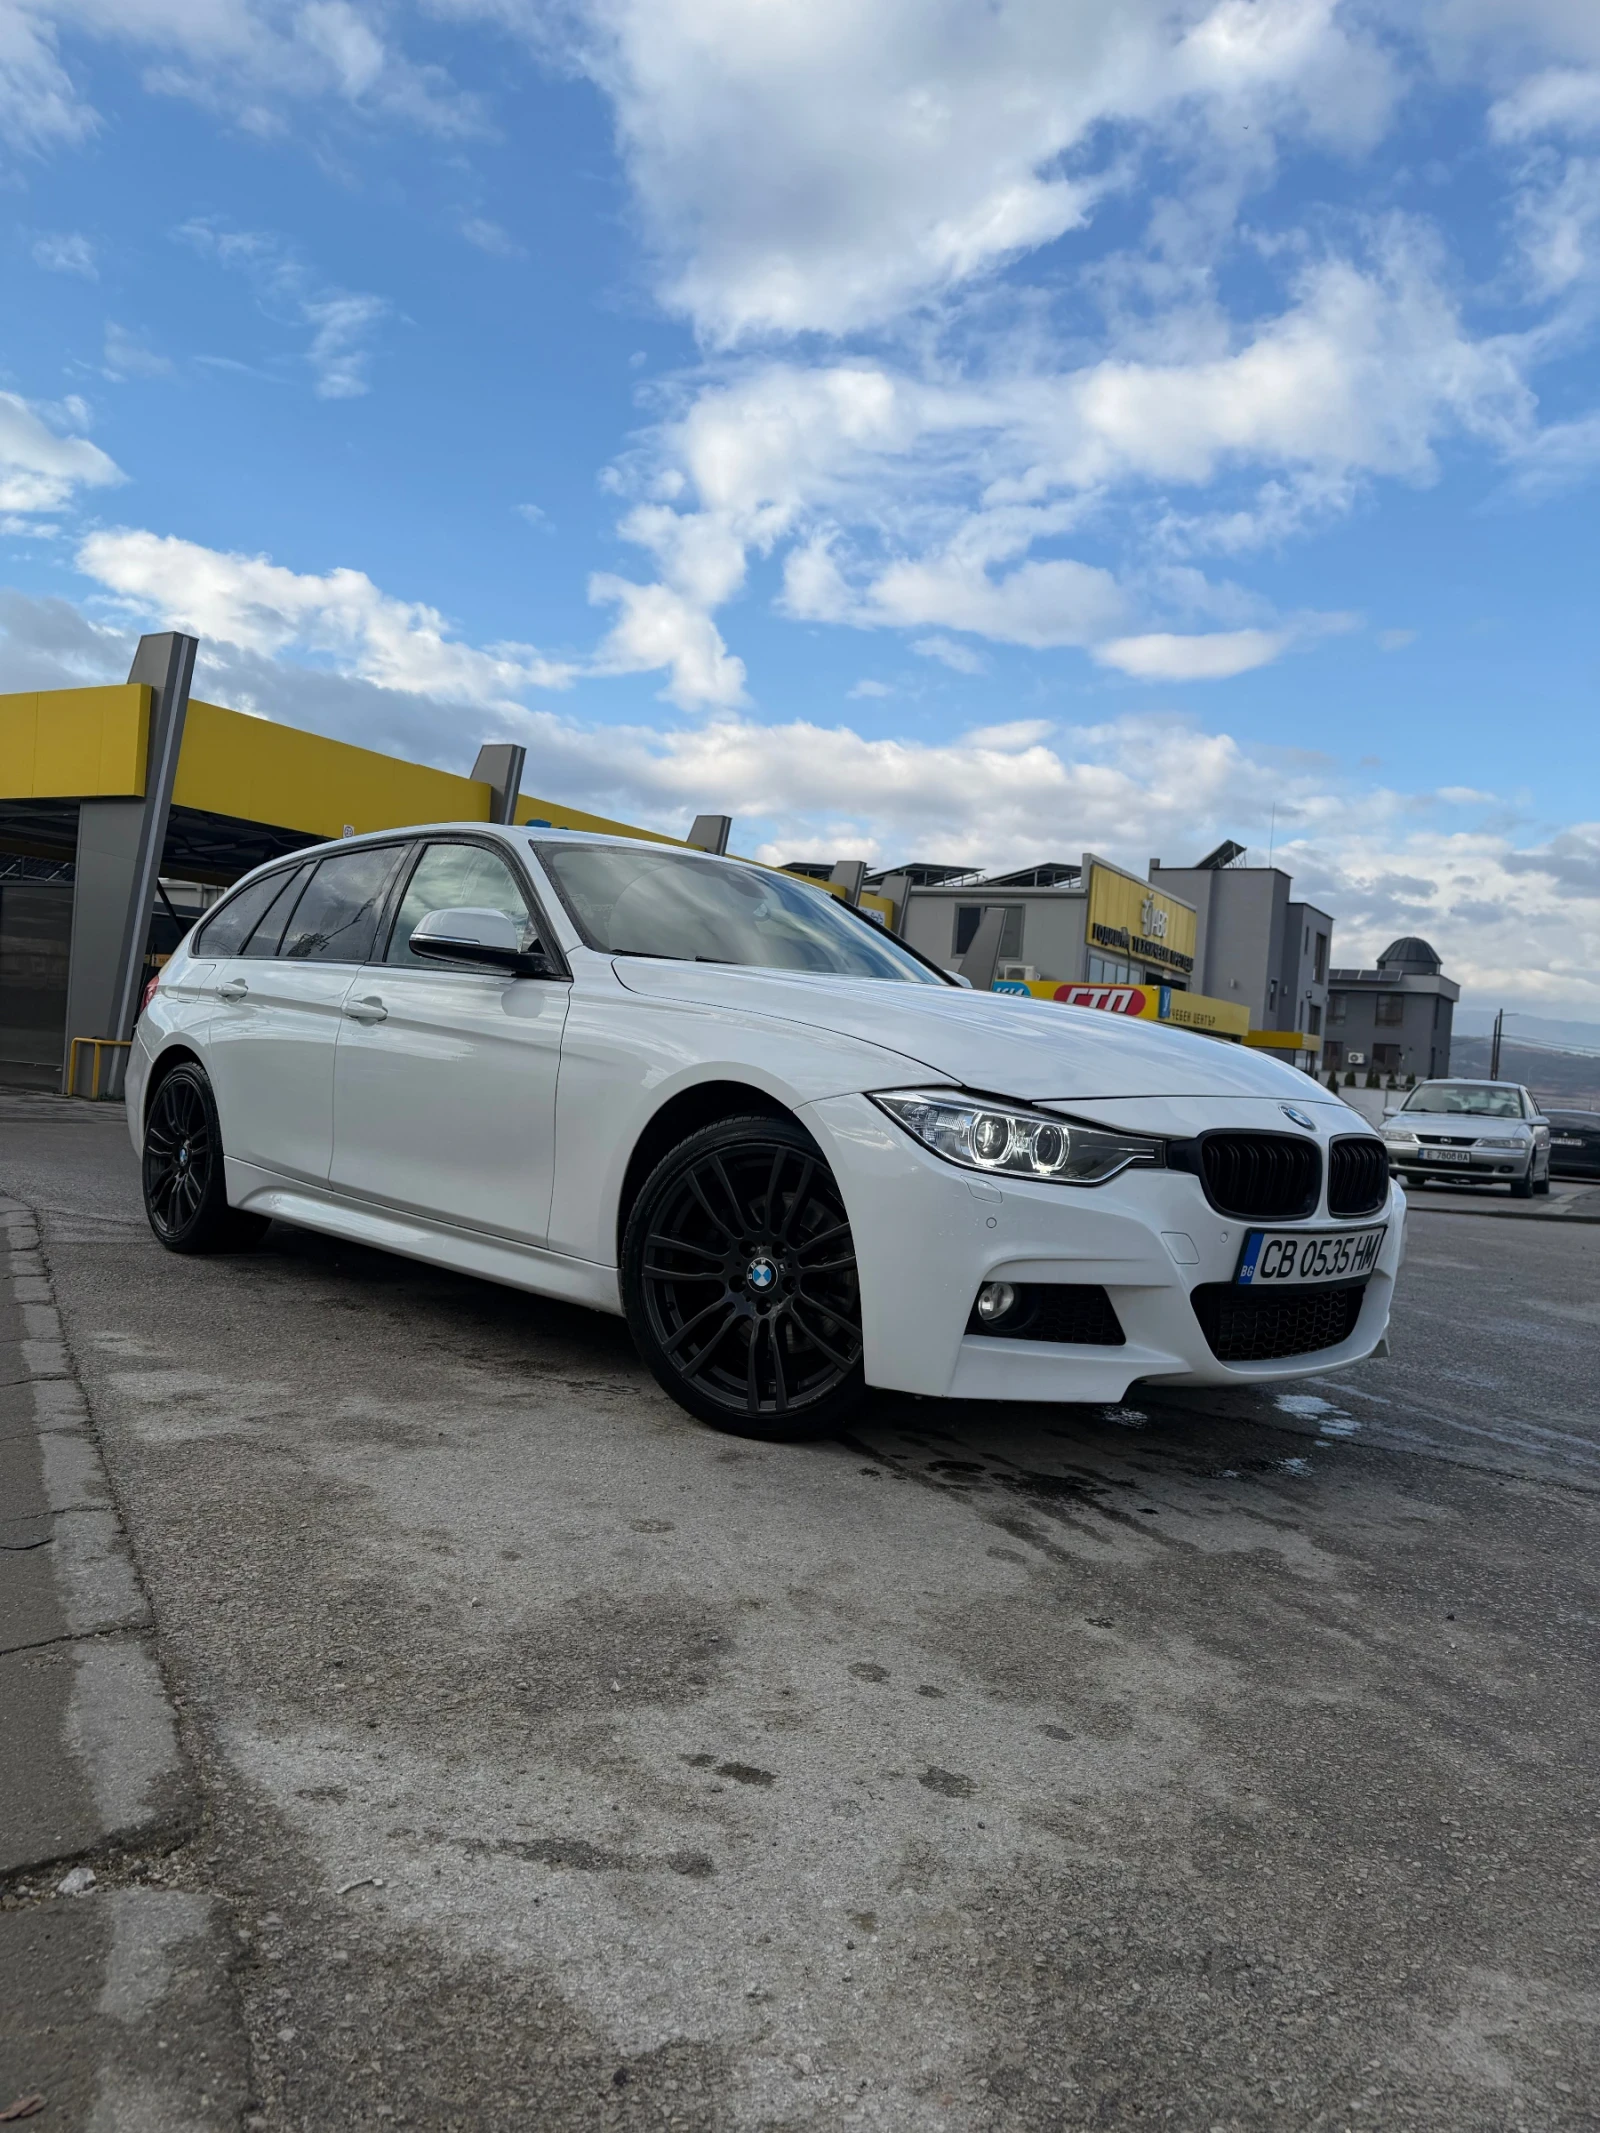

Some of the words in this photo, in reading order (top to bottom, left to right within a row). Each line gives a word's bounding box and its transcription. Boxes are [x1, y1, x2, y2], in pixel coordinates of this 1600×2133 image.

[1170, 1007, 1191, 1022] ЧЕБЕН
[1240, 1265, 1254, 1277] BG
[1260, 1239, 1298, 1279] CB
[1300, 1237, 1355, 1278] 0535
[1350, 1234, 1380, 1272] HM
